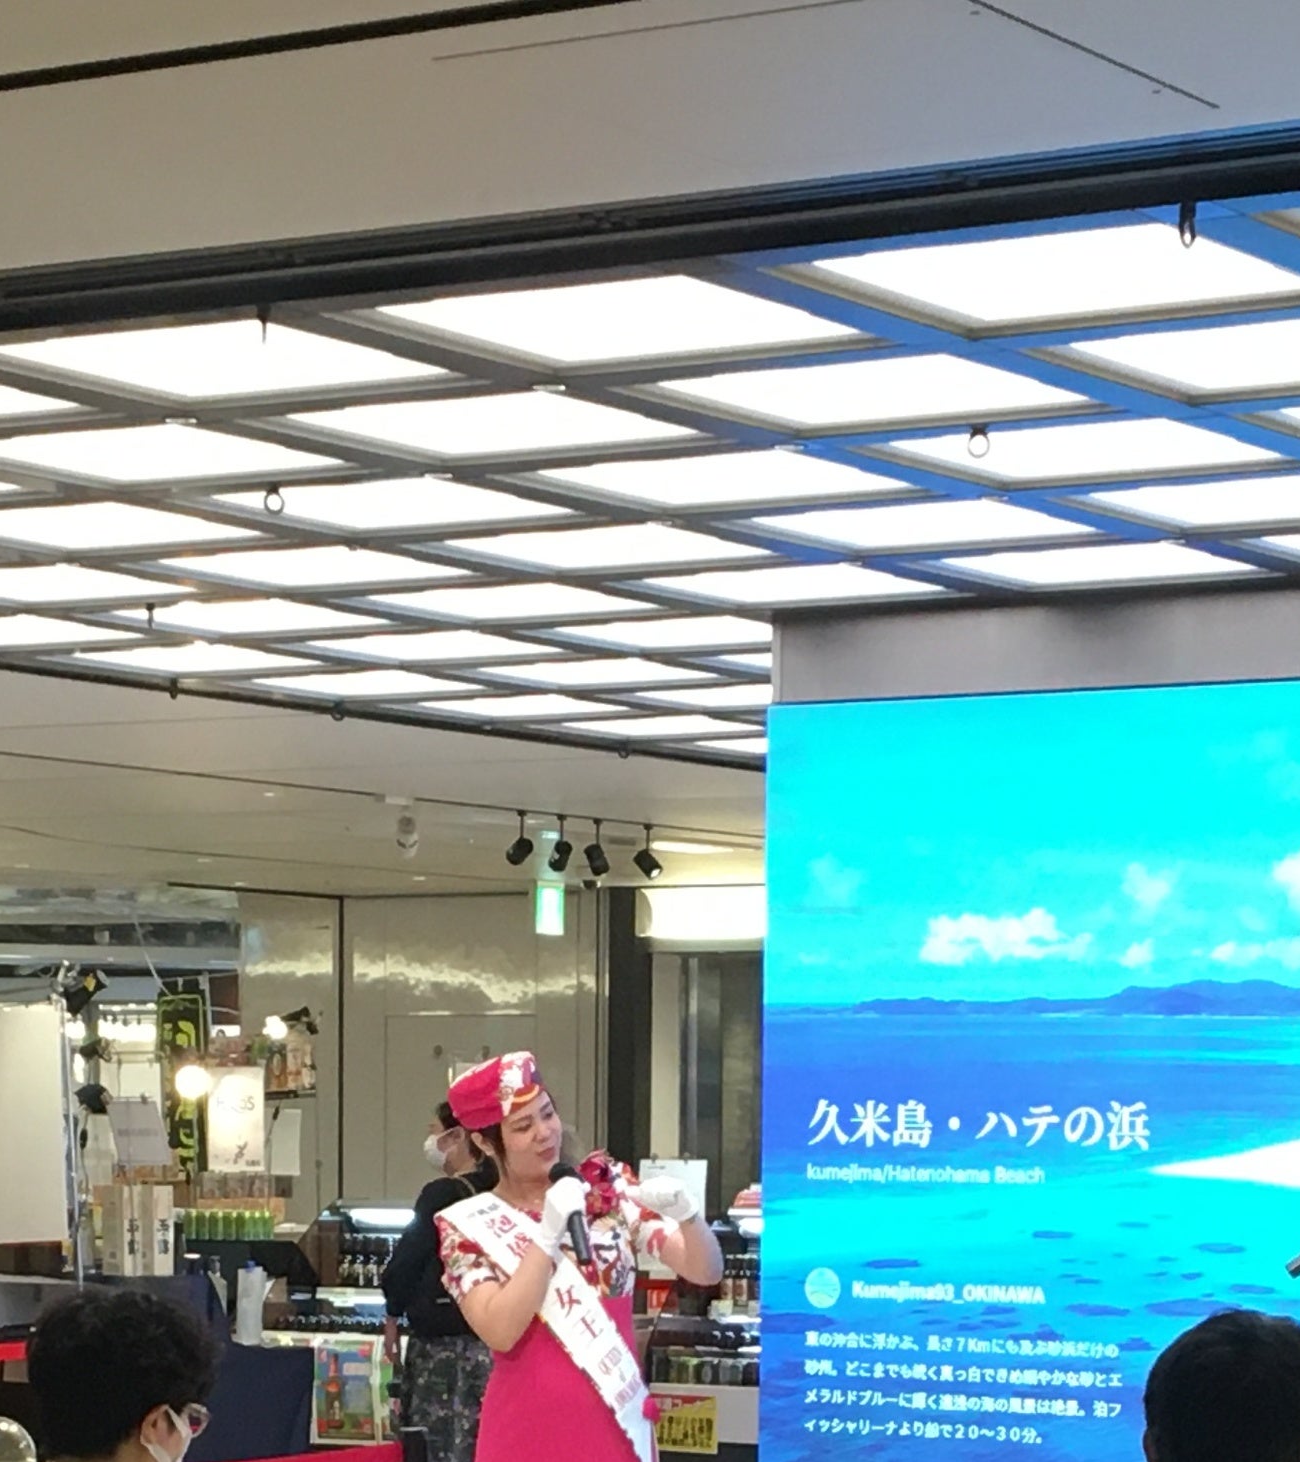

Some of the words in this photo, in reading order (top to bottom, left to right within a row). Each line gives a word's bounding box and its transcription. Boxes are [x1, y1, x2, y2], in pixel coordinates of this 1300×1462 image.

[807, 1099, 1150, 1152] 久米島・ハテの浜
[995, 1166, 1045, 1184] Beach
